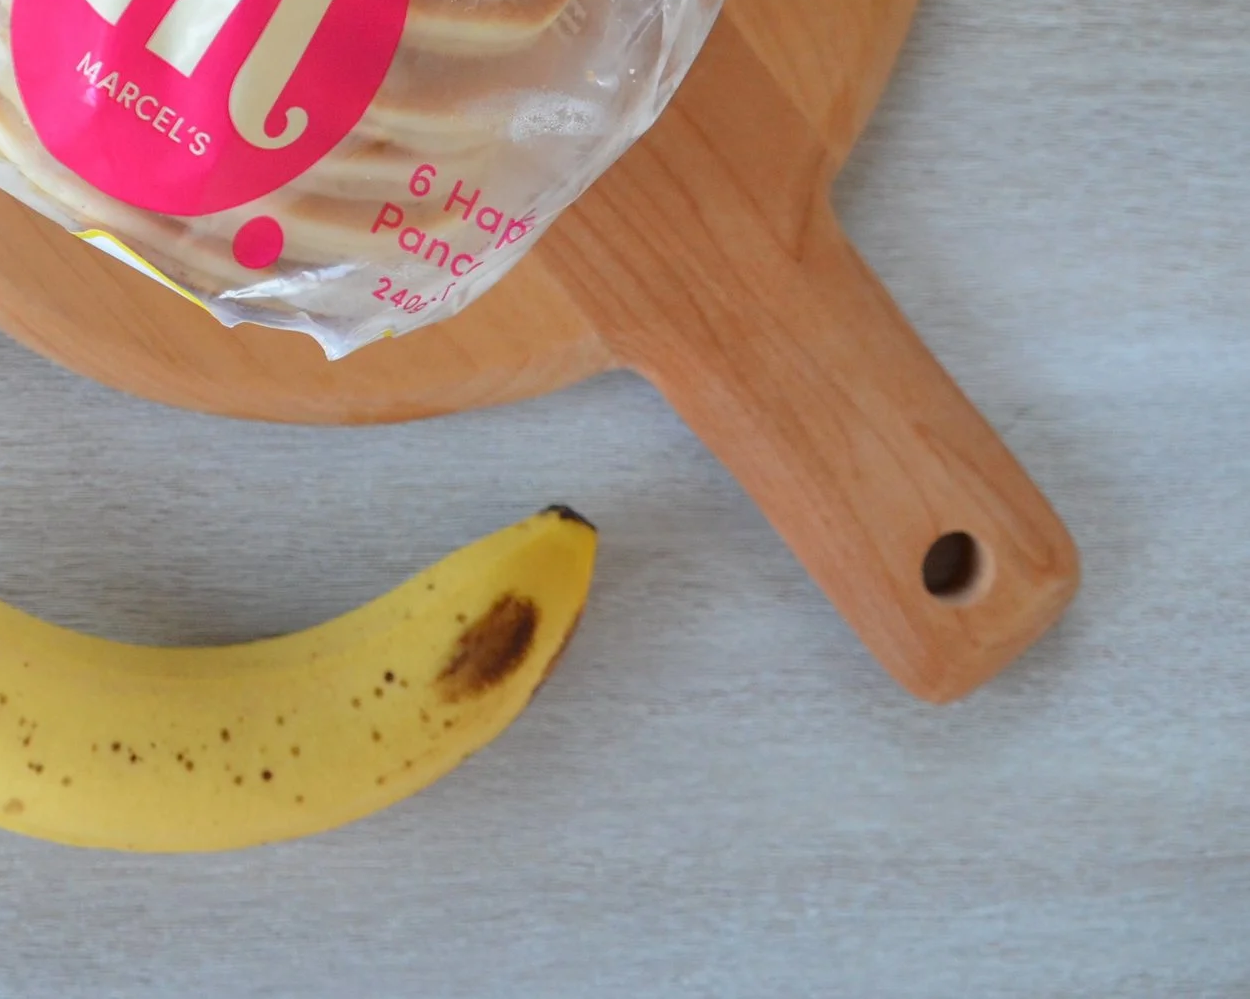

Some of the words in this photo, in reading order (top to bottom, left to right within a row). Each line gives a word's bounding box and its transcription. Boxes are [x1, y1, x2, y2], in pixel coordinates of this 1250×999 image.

[76, 51, 213, 156] MARCEL'S
[370, 202, 484, 277] Panc
[408, 163, 437, 197] 6
[443, 179, 536, 250] Hap
